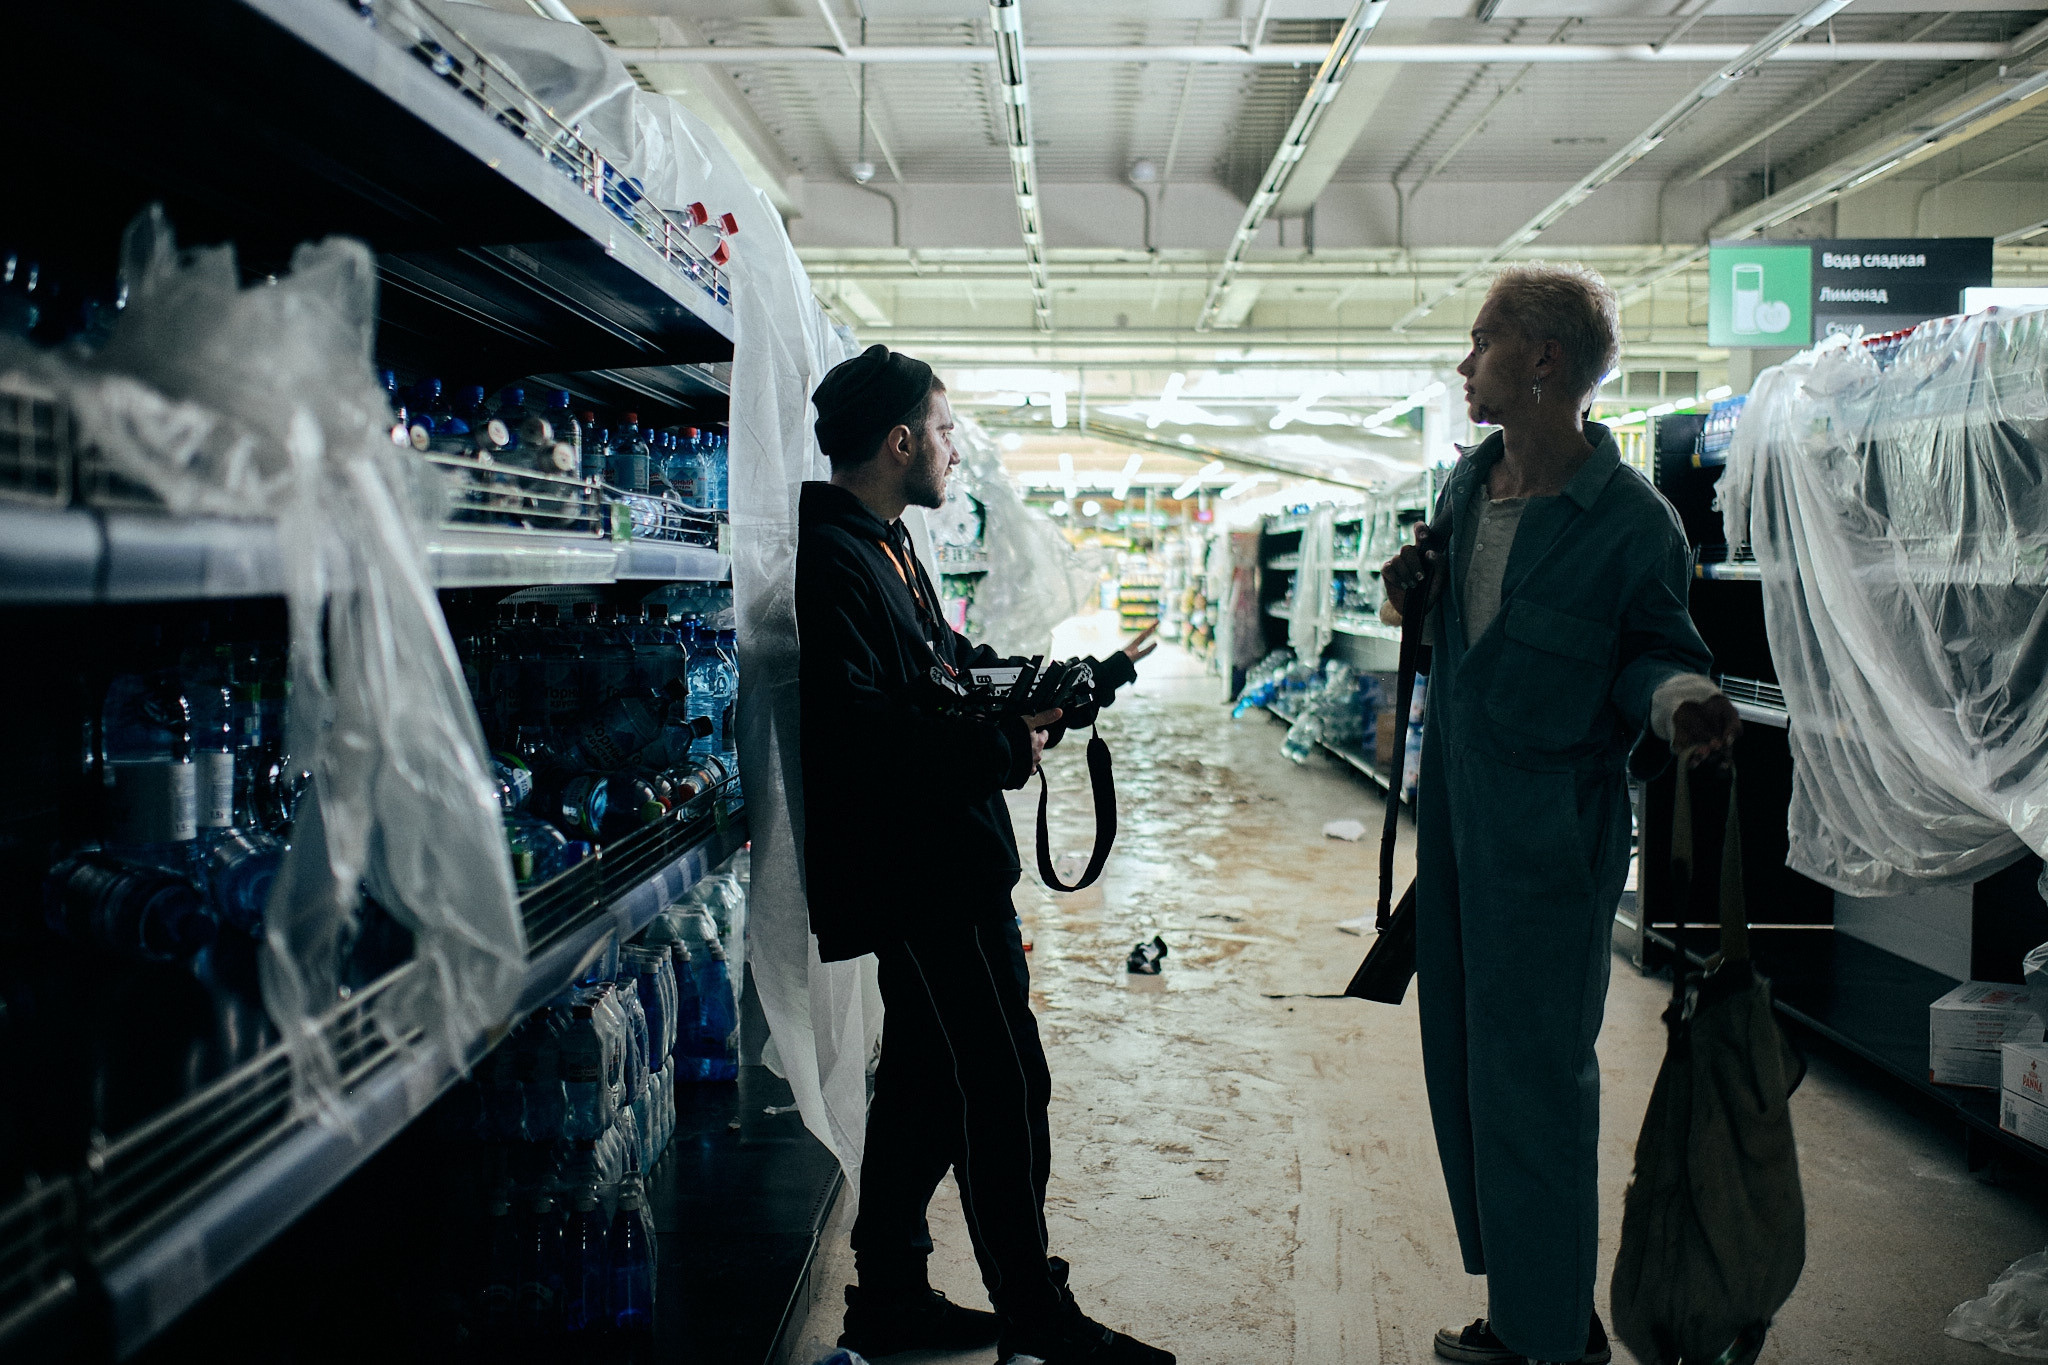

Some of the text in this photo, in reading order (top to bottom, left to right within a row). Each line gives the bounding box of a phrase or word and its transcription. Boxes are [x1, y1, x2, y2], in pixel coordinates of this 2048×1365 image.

[1822, 252, 1926, 269] Вода сладкая
[1819, 286, 1888, 304] Лимонад
[2022, 1073, 2043, 1093] PANNA
